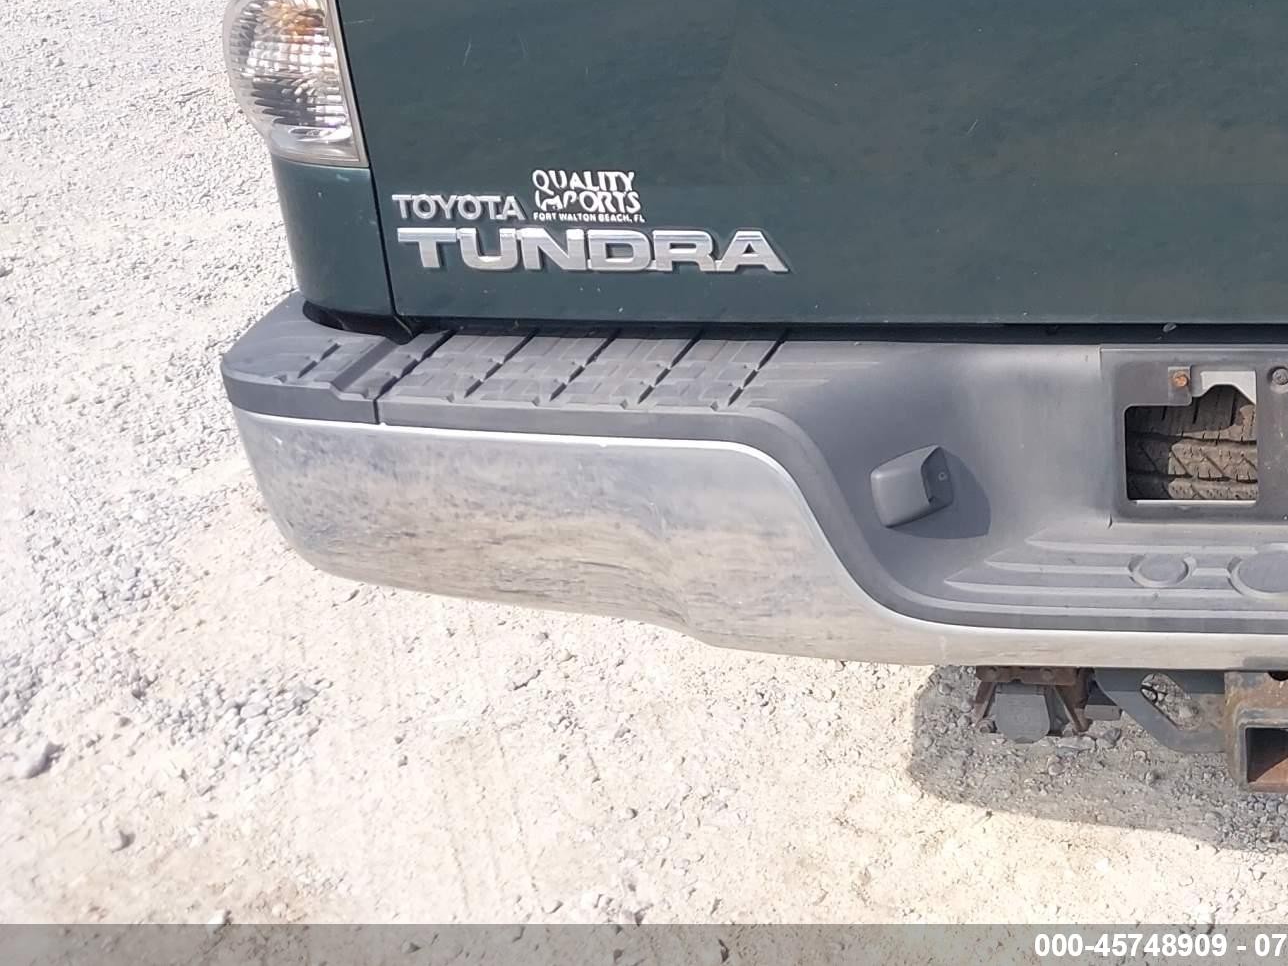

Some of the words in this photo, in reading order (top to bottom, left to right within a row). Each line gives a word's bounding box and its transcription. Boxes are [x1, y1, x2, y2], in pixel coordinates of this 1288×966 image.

[532, 169, 635, 192] QUALITY
[392, 194, 525, 220] TOYOTA
[534, 212, 557, 221] FORT
[559, 212, 597, 222] WALTON
[633, 214, 646, 223] FL
[397, 227, 789, 272] TUNDRA
